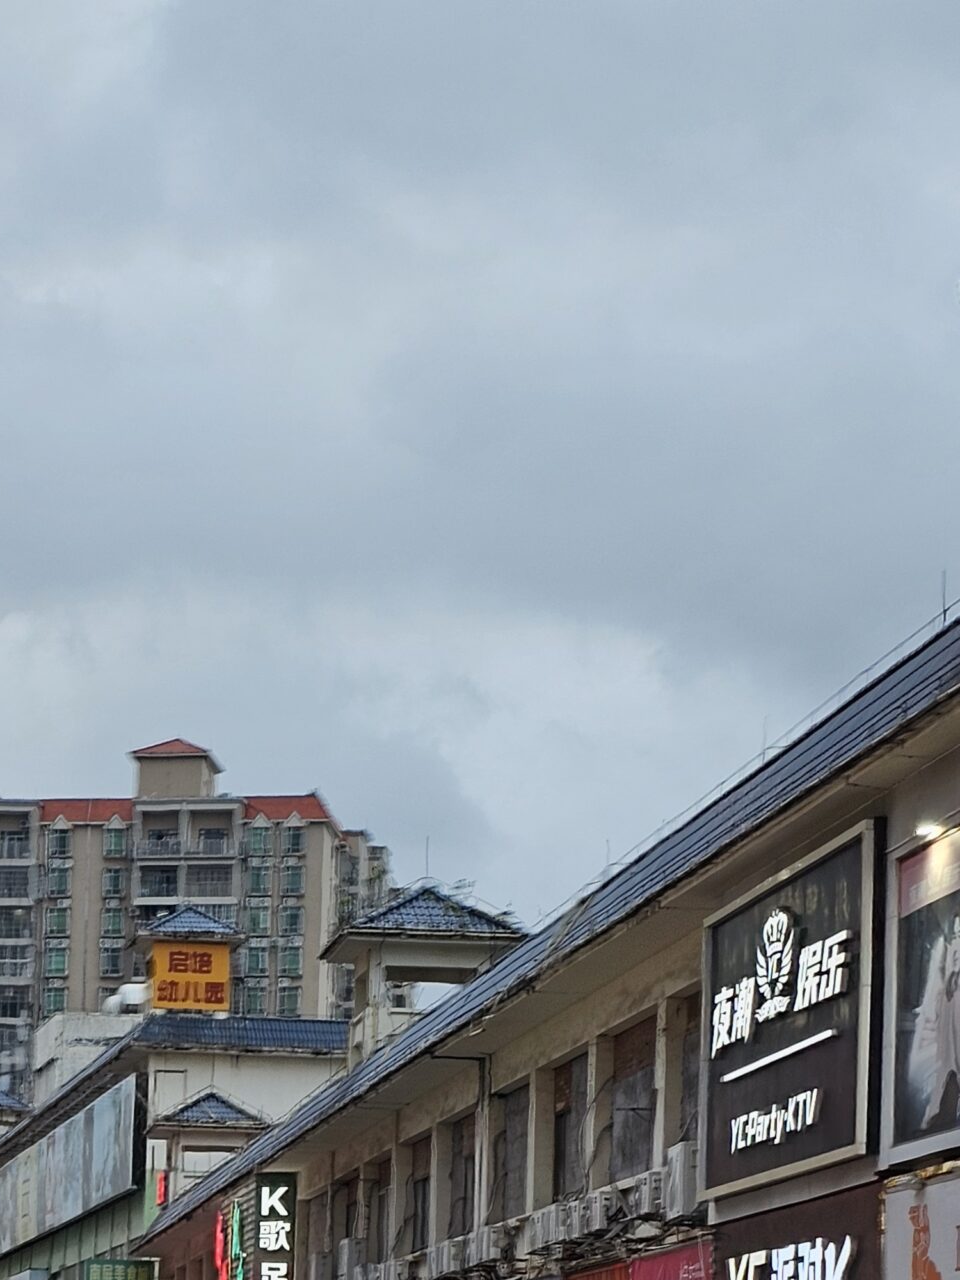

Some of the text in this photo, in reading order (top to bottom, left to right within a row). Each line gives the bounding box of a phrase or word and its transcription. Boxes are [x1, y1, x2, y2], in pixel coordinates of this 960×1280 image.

[157, 980, 224, 1004] 幼儿园
[794, 929, 853, 1012] 娱乐
